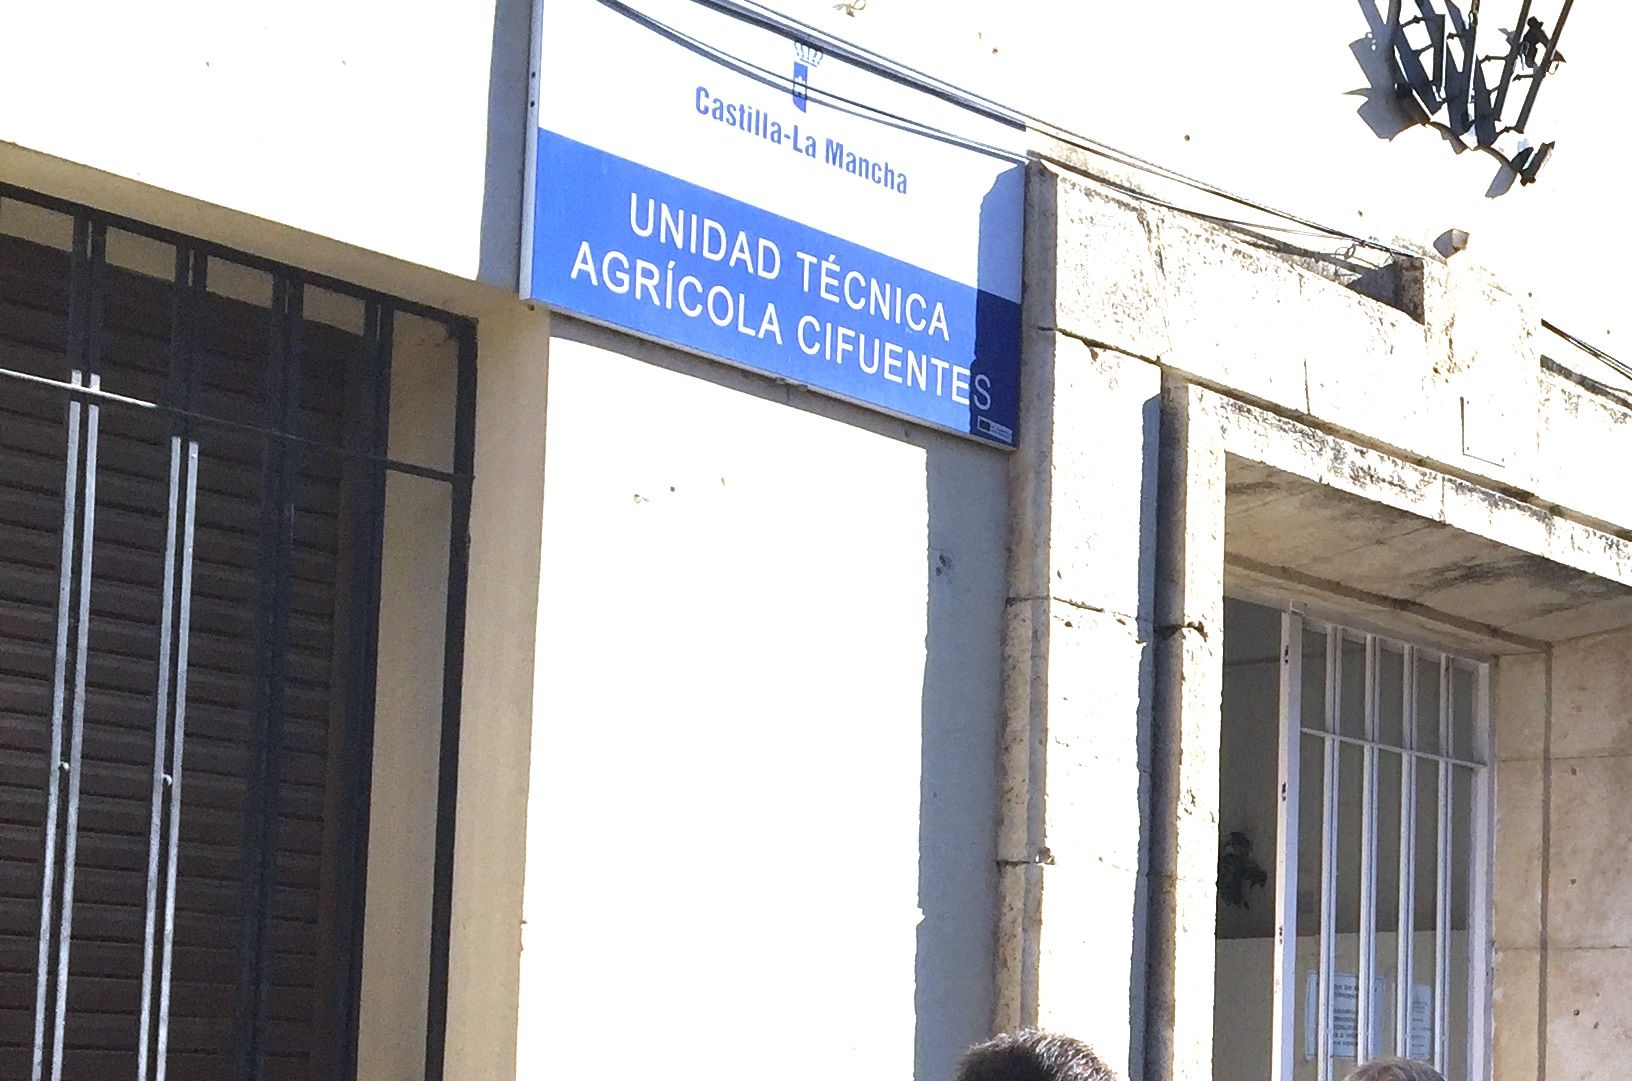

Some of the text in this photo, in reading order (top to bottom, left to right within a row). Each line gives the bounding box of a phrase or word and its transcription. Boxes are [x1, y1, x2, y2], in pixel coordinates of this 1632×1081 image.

[695, 85, 908, 194] Castilla-La Mancha
[570, 240, 991, 410] AGRÍCOLA CIFUENTES
[630, 192, 950, 342] UNIDAD TÉCNICA
